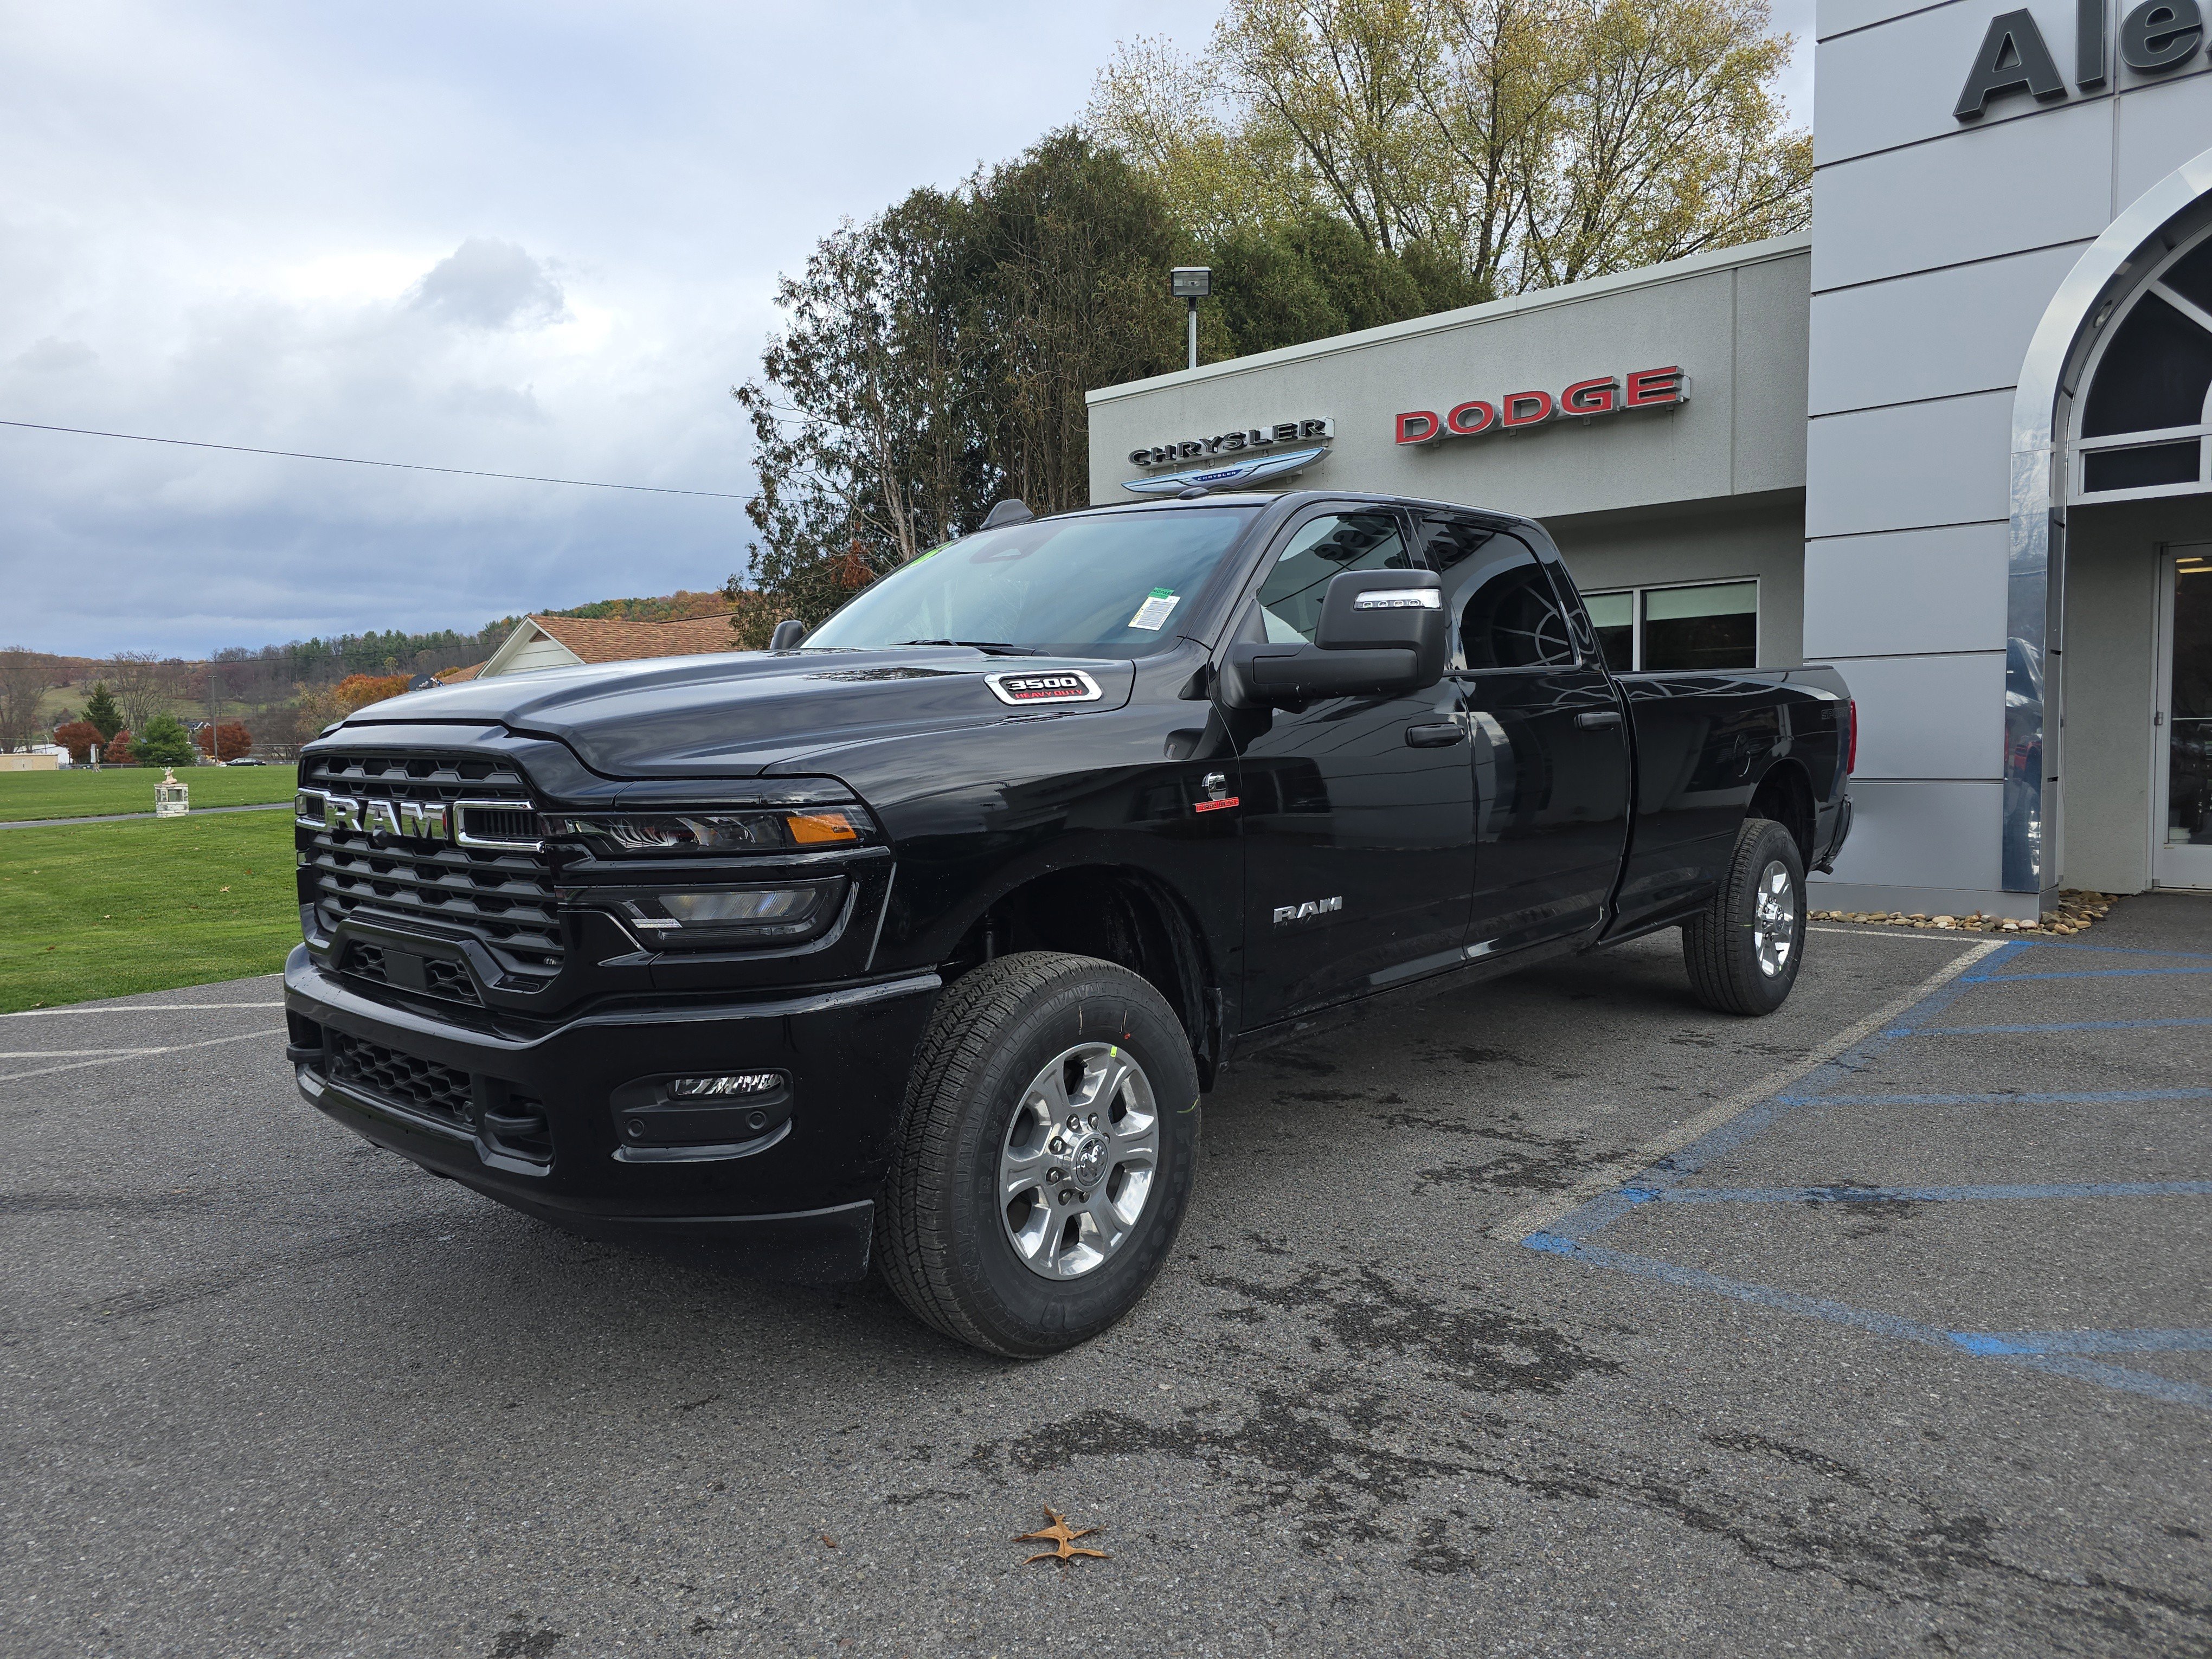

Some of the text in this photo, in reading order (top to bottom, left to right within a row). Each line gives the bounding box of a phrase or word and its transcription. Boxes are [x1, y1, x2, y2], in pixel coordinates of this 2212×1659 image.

[1952, 0, 2212, 123] Ale
[1395, 365, 1684, 446] DODGE
[1128, 419, 1326, 466] CHRYSLER
[1197, 471, 1237, 481] CHRYSLER
[1007, 677, 1078, 691] 3500
[326, 796, 448, 840] RAM
[1274, 896, 1342, 923] RAM
